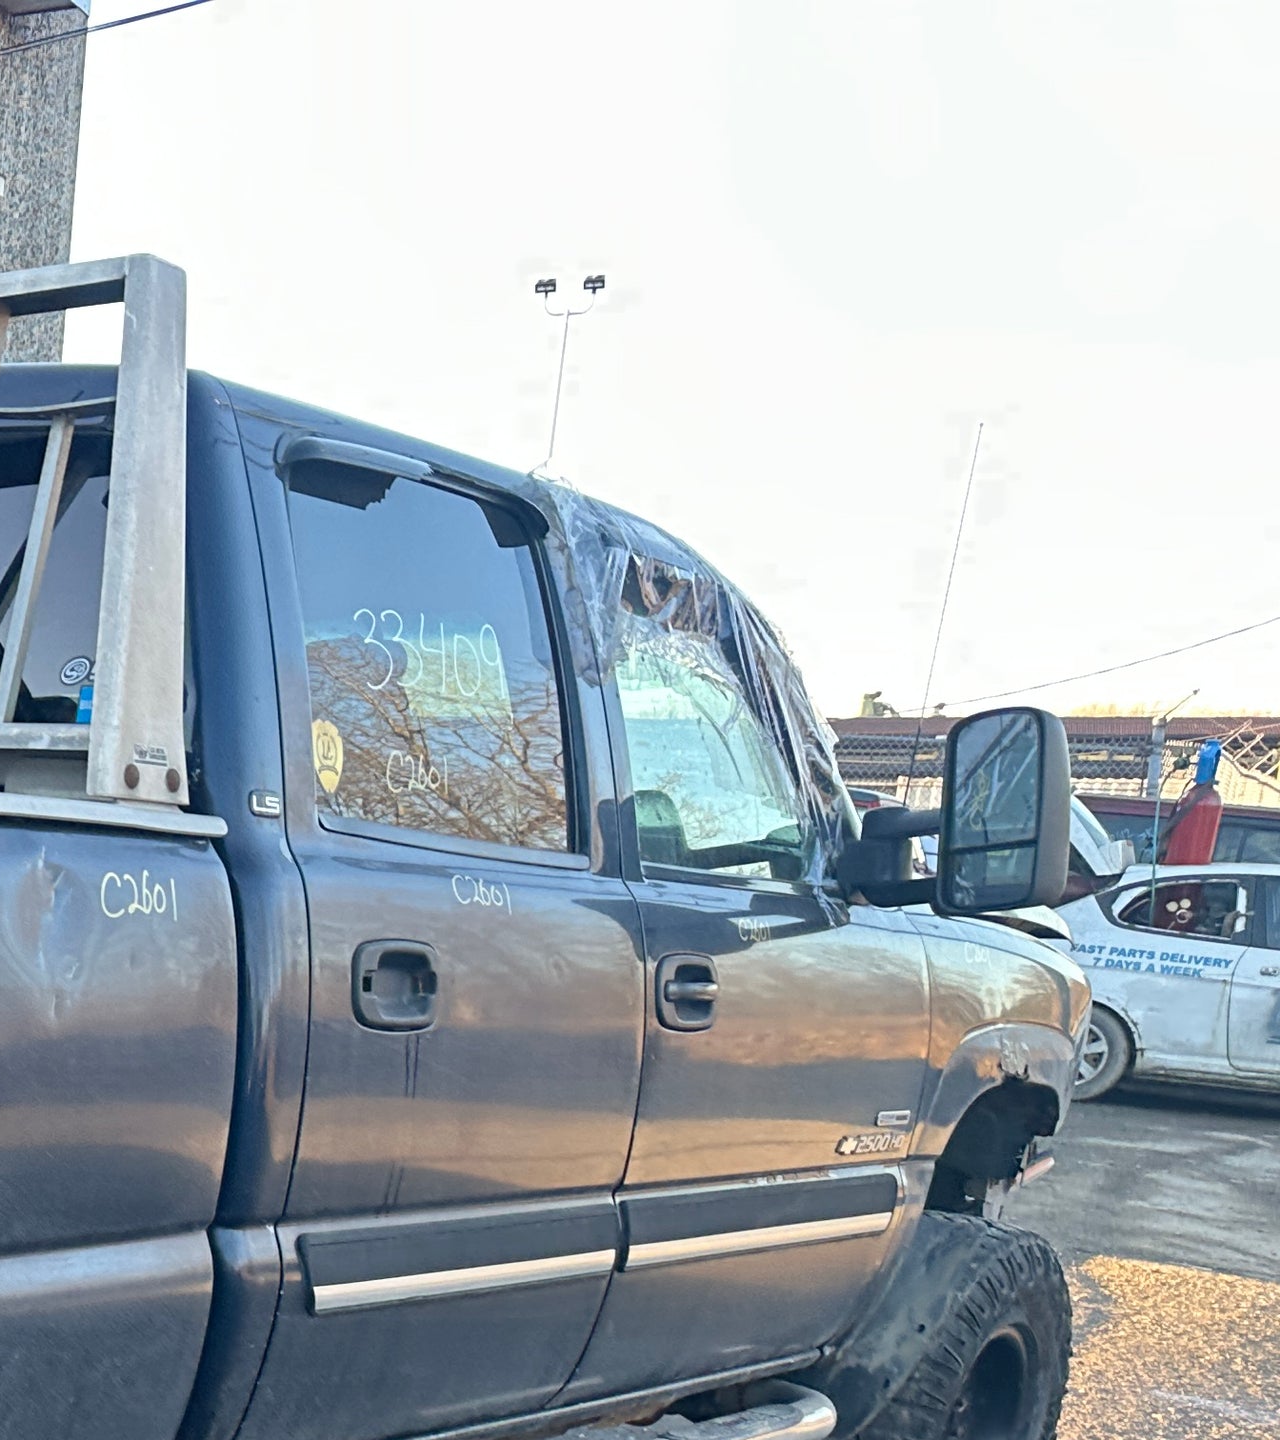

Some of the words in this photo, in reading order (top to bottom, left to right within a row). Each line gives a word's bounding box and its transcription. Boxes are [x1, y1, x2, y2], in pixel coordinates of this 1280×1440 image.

[353, 607, 507, 700] 33409
[386, 750, 449, 796] C2601
[251, 794, 281, 814] LS
[100, 869, 178, 922] C2601
[451, 874, 513, 916] C2601
[737, 919, 771, 942] C2601
[1092, 957, 1102, 967] 7
[1104, 958, 1143, 971] DAYS
[1145, 963, 1155, 974] A
[1160, 964, 1204, 978] WEEK
[1109, 946, 1156, 960] PARTS
[1159, 951, 1234, 969] DELIVERY
